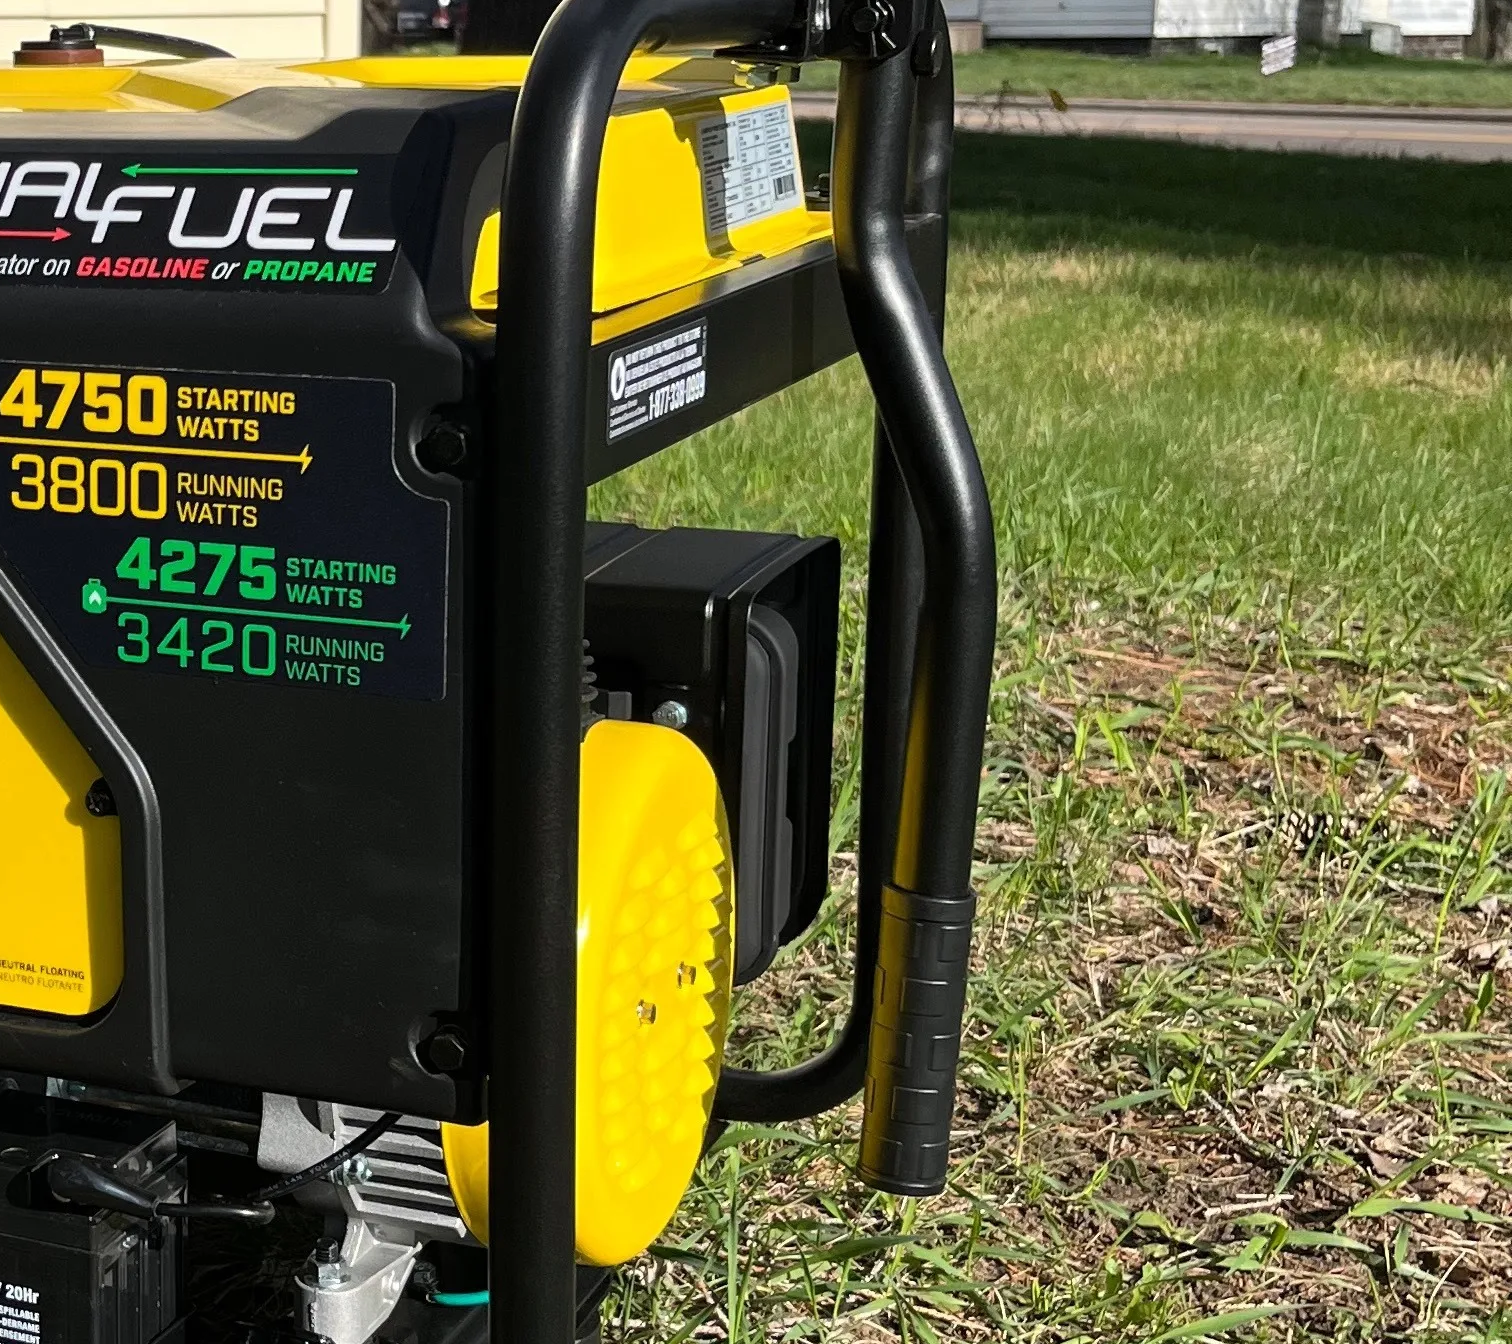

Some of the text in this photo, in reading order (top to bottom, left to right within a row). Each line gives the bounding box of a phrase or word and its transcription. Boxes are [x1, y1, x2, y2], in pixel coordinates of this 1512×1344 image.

[42, 260, 71, 278] on
[75, 256, 210, 280] GASOLINE
[211, 262, 240, 281] or
[243, 259, 377, 284] PROPANE
[176, 386, 296, 415] STARTING
[176, 415, 260, 442] WATTS
[10, 454, 284, 520] 3800 RUNNING
[176, 499, 258, 528] WATTS
[115, 536, 397, 601] 4275 STARTING
[286, 582, 364, 609] WATTS
[116, 611, 385, 677] 3420 RUNNING
[284, 660, 362, 687] WATTS
[36, 976, 84, 993] FLOTANTE
[39, 964, 85, 980] FLOATING
[5, 1283, 40, 1304] 20Hr
